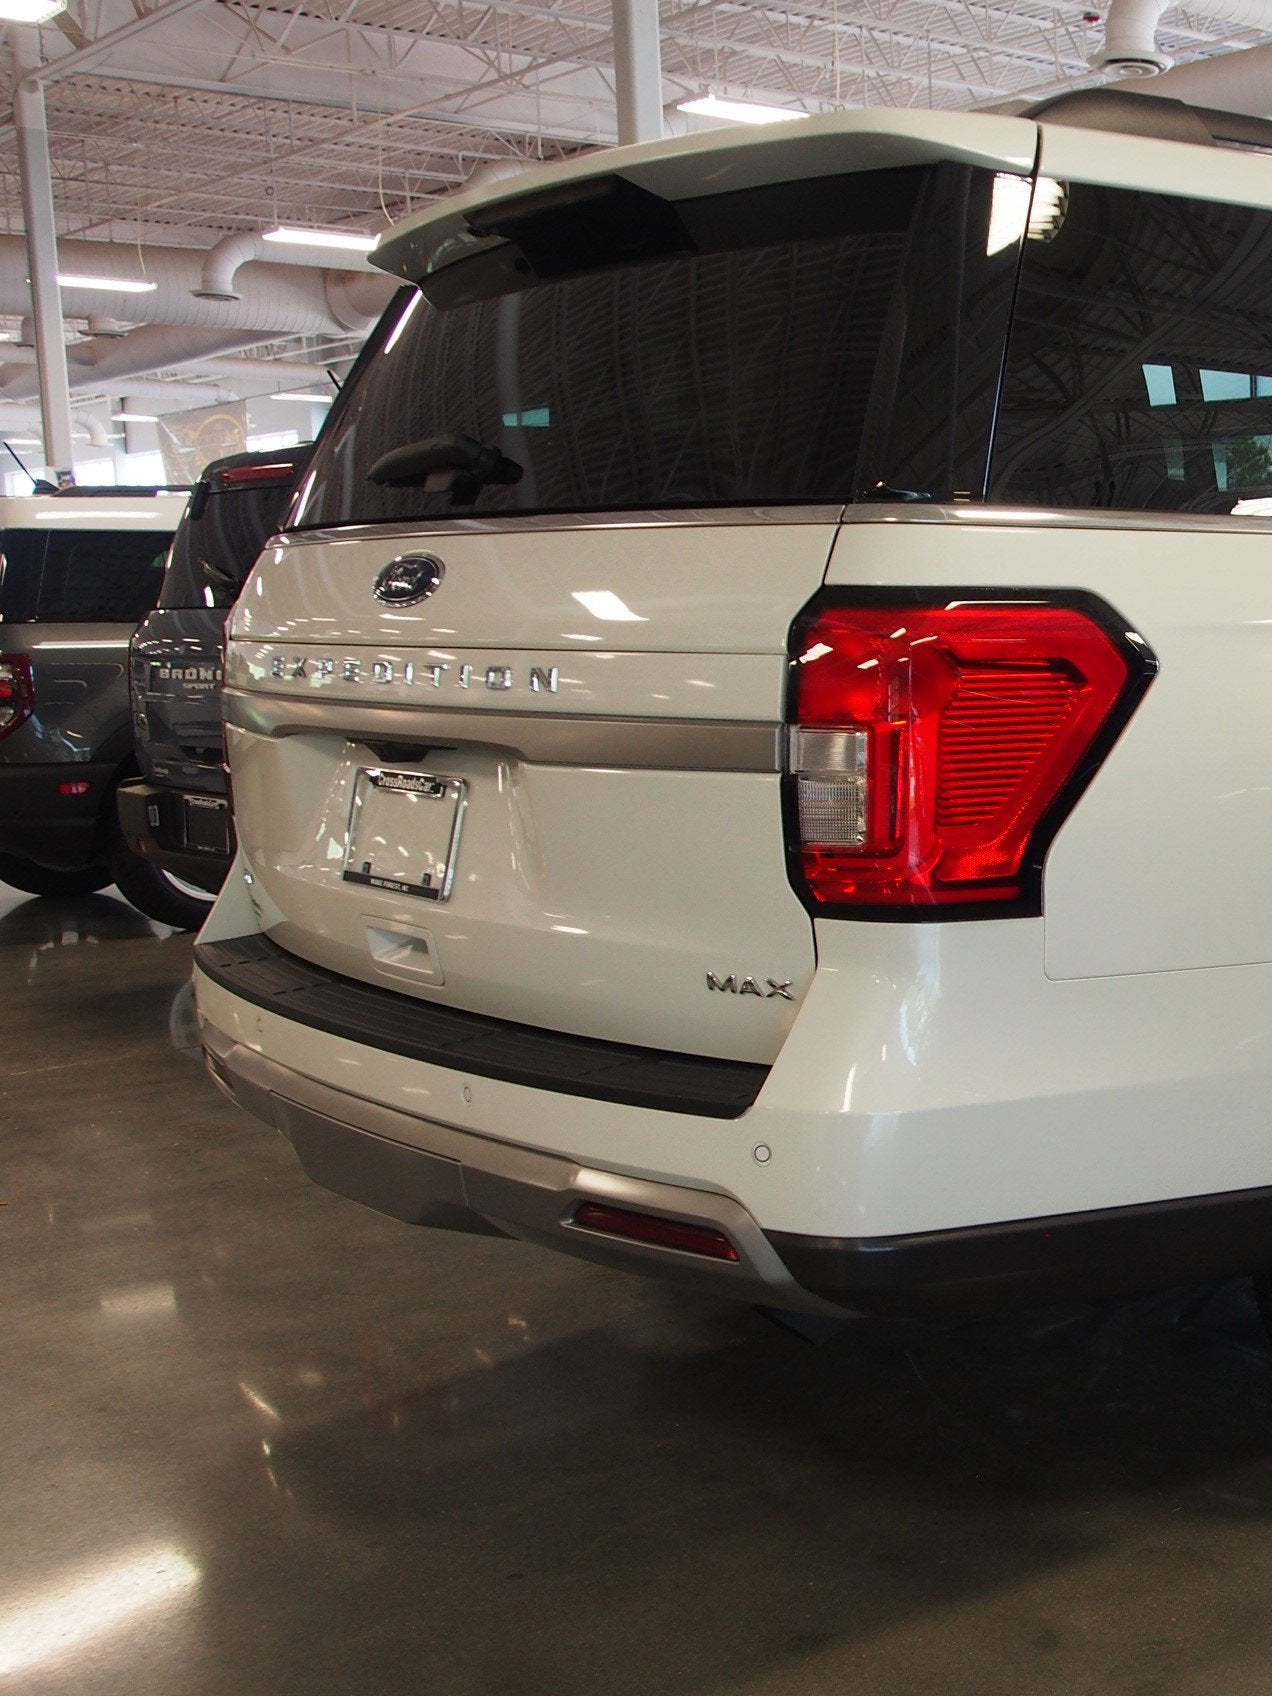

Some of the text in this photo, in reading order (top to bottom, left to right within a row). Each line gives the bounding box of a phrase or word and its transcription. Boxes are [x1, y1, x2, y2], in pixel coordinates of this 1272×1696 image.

[182, 682, 216, 690] SPORT
[271, 656, 559, 693] EXPEDITION
[706, 971, 795, 1001] MAX
